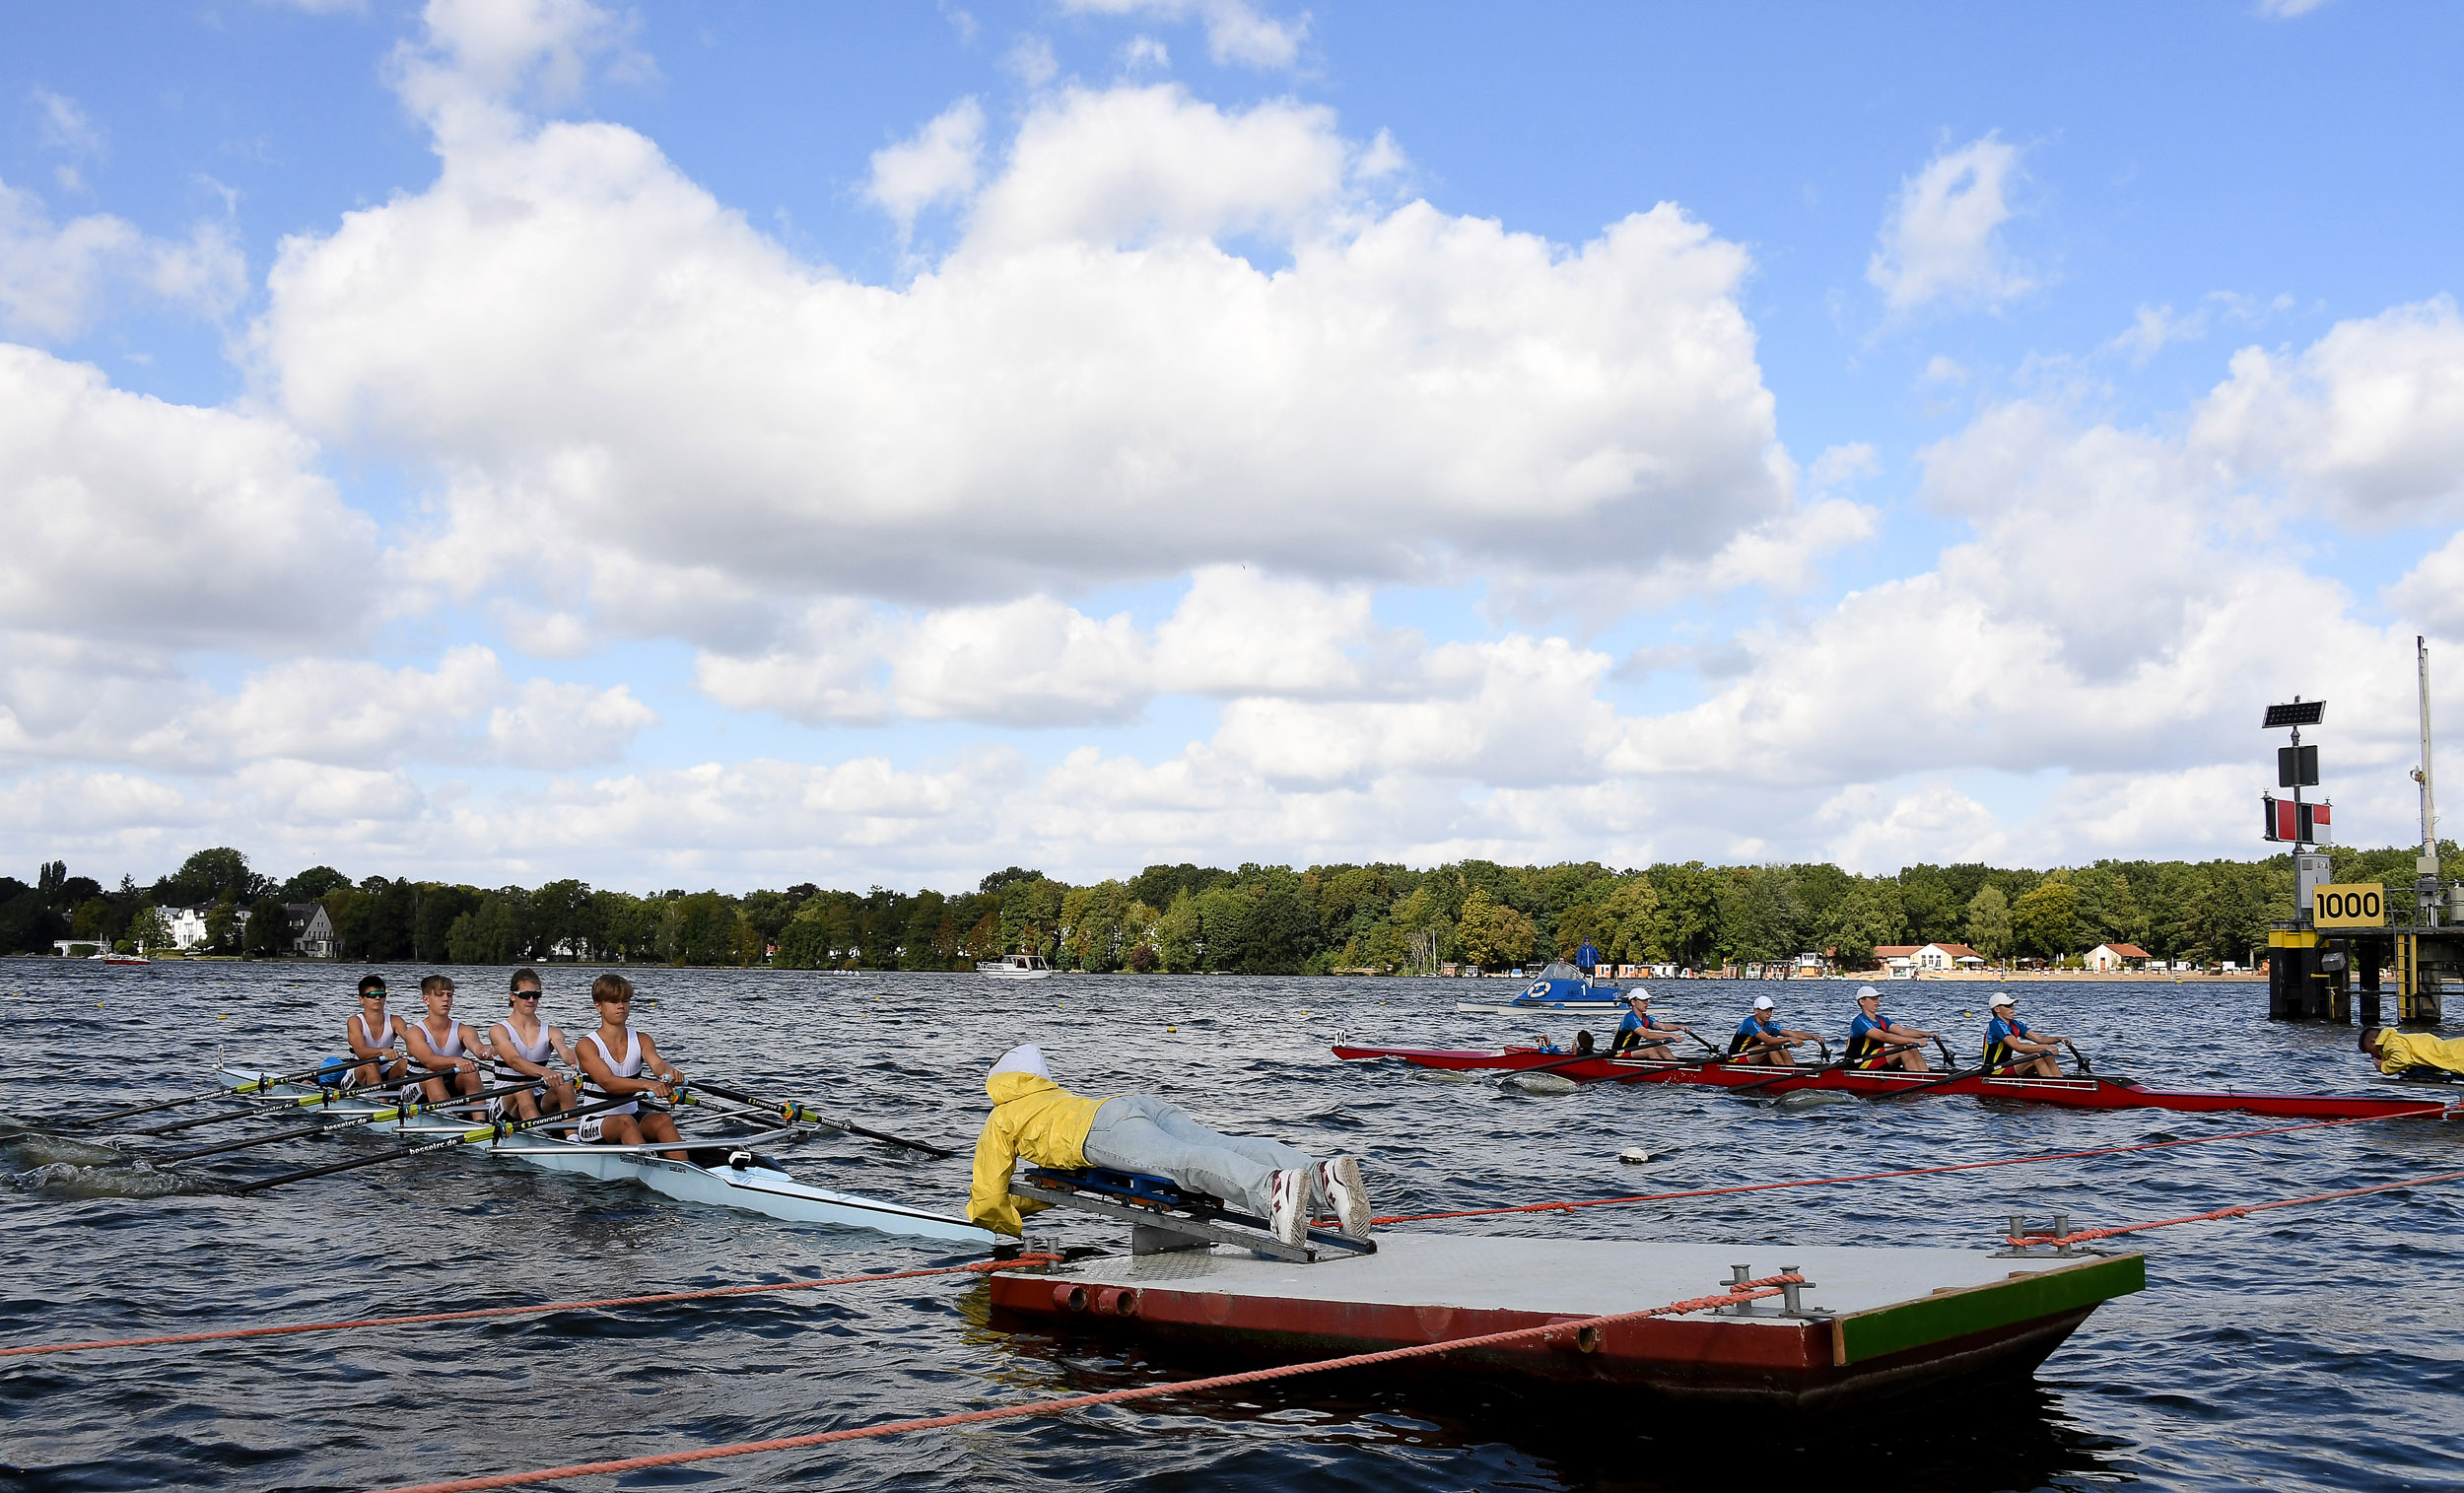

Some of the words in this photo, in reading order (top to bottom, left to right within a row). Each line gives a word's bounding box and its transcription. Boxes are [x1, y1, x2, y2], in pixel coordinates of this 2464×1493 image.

[2316, 891, 2380, 919] 1000
[1580, 984, 1587, 996] 1
[1335, 1031, 1345, 1045] 14
[532, 1115, 563, 1126] concept
[409, 1138, 457, 1155] besselrc.de
